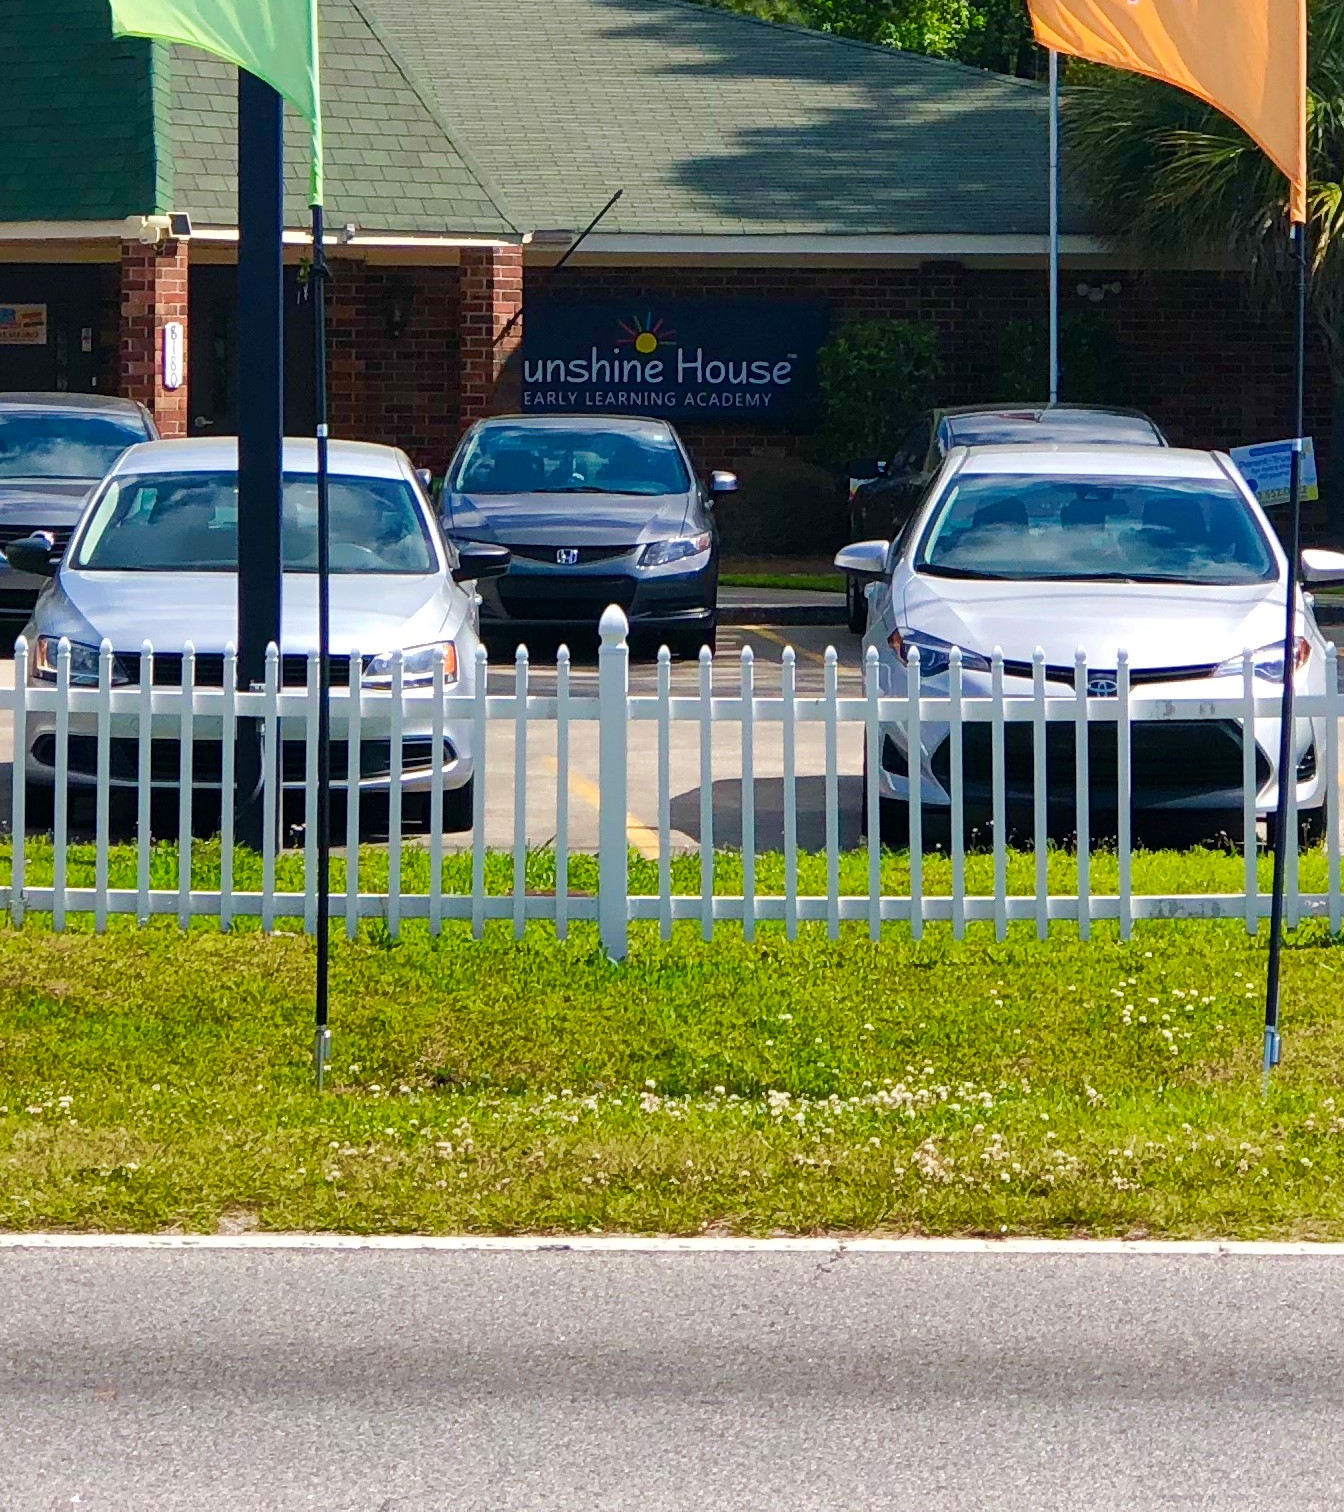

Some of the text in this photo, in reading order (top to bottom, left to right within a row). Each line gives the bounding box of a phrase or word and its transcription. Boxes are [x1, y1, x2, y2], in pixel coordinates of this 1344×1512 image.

[524, 346, 664, 383] unshine
[524, 391, 772, 407] EARLY LEARNING ACADEMY
